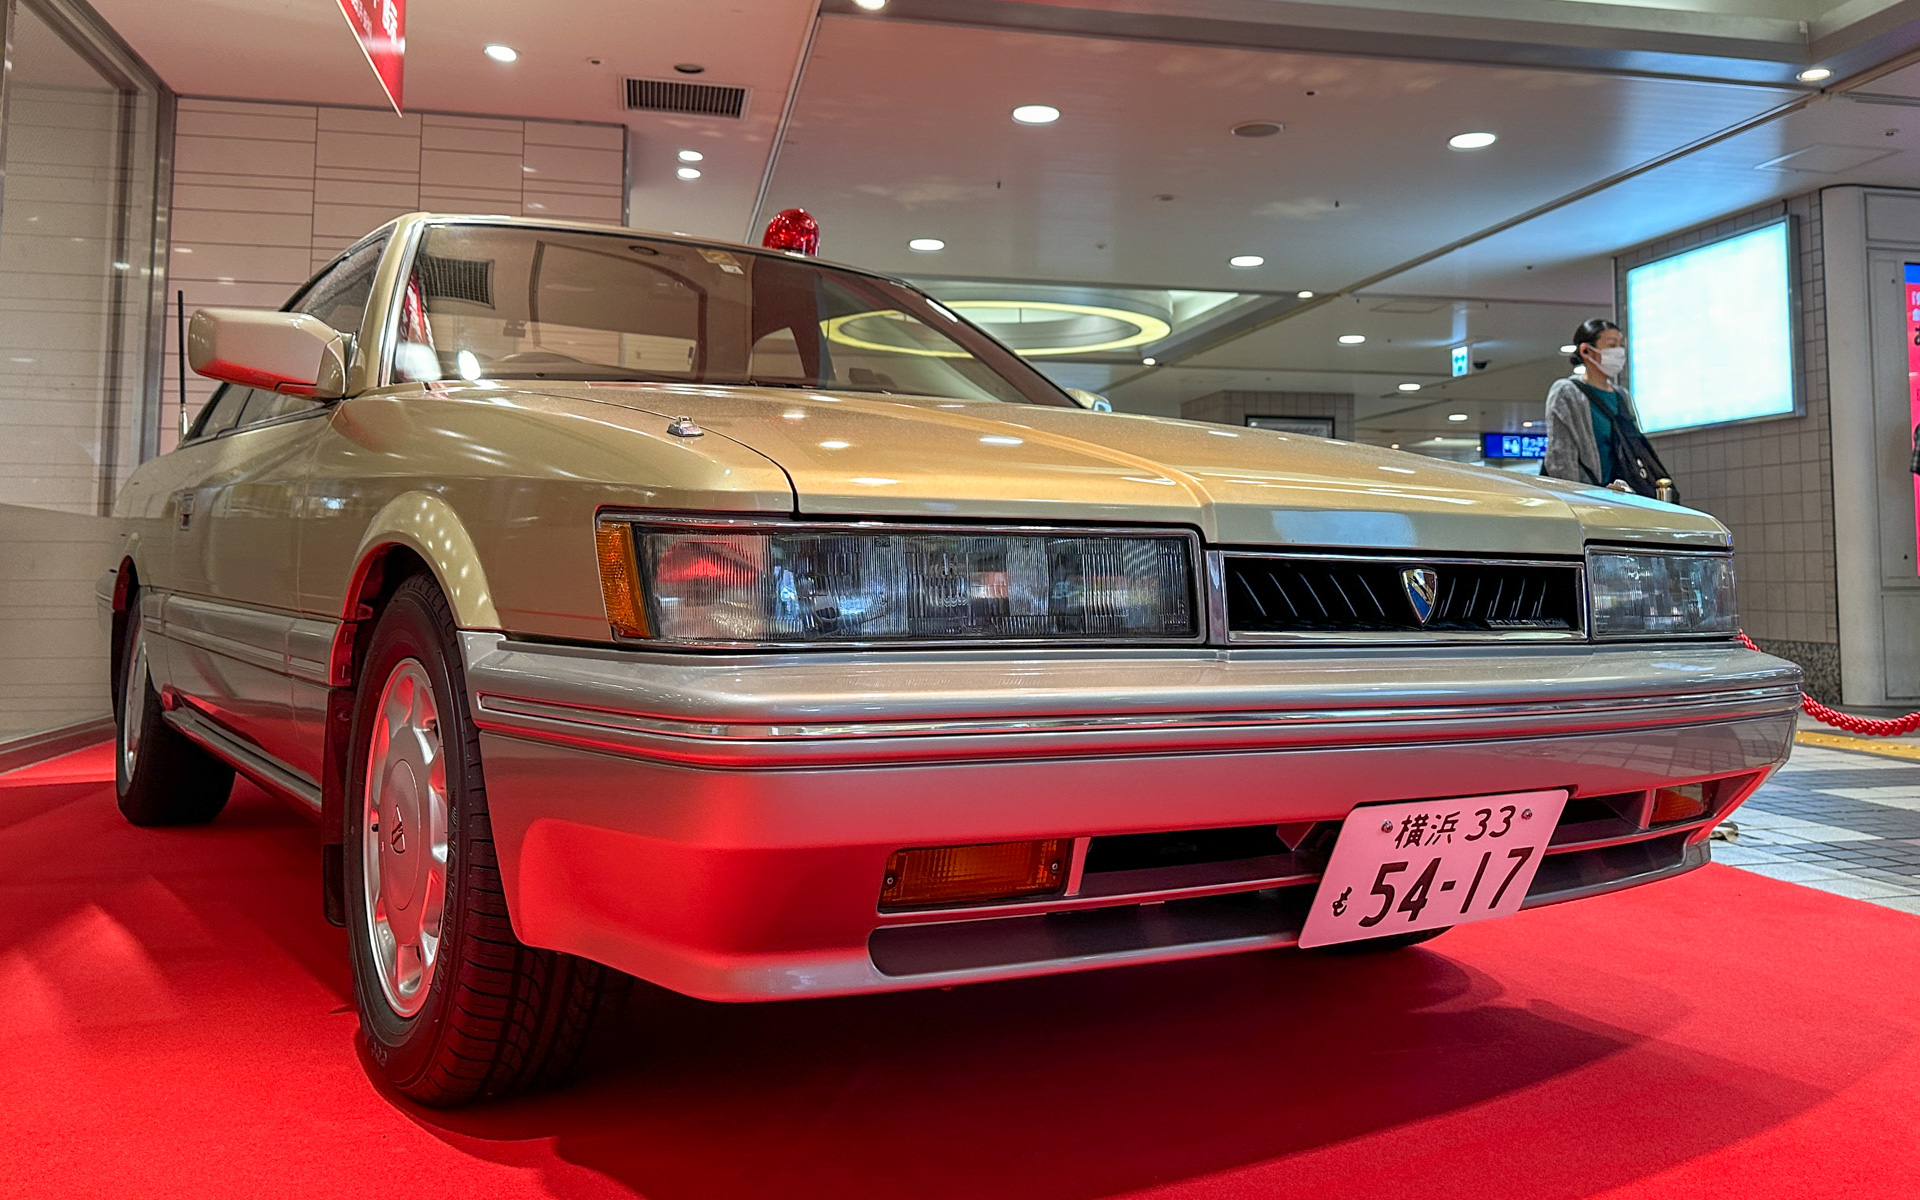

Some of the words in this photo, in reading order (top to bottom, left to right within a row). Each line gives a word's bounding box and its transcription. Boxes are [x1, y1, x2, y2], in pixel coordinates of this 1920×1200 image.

[1395, 811, 1461, 849] 横浜
[1464, 805, 1516, 841] 33
[1332, 886, 1352, 917] も
[1358, 846, 1535, 928] 54-17
